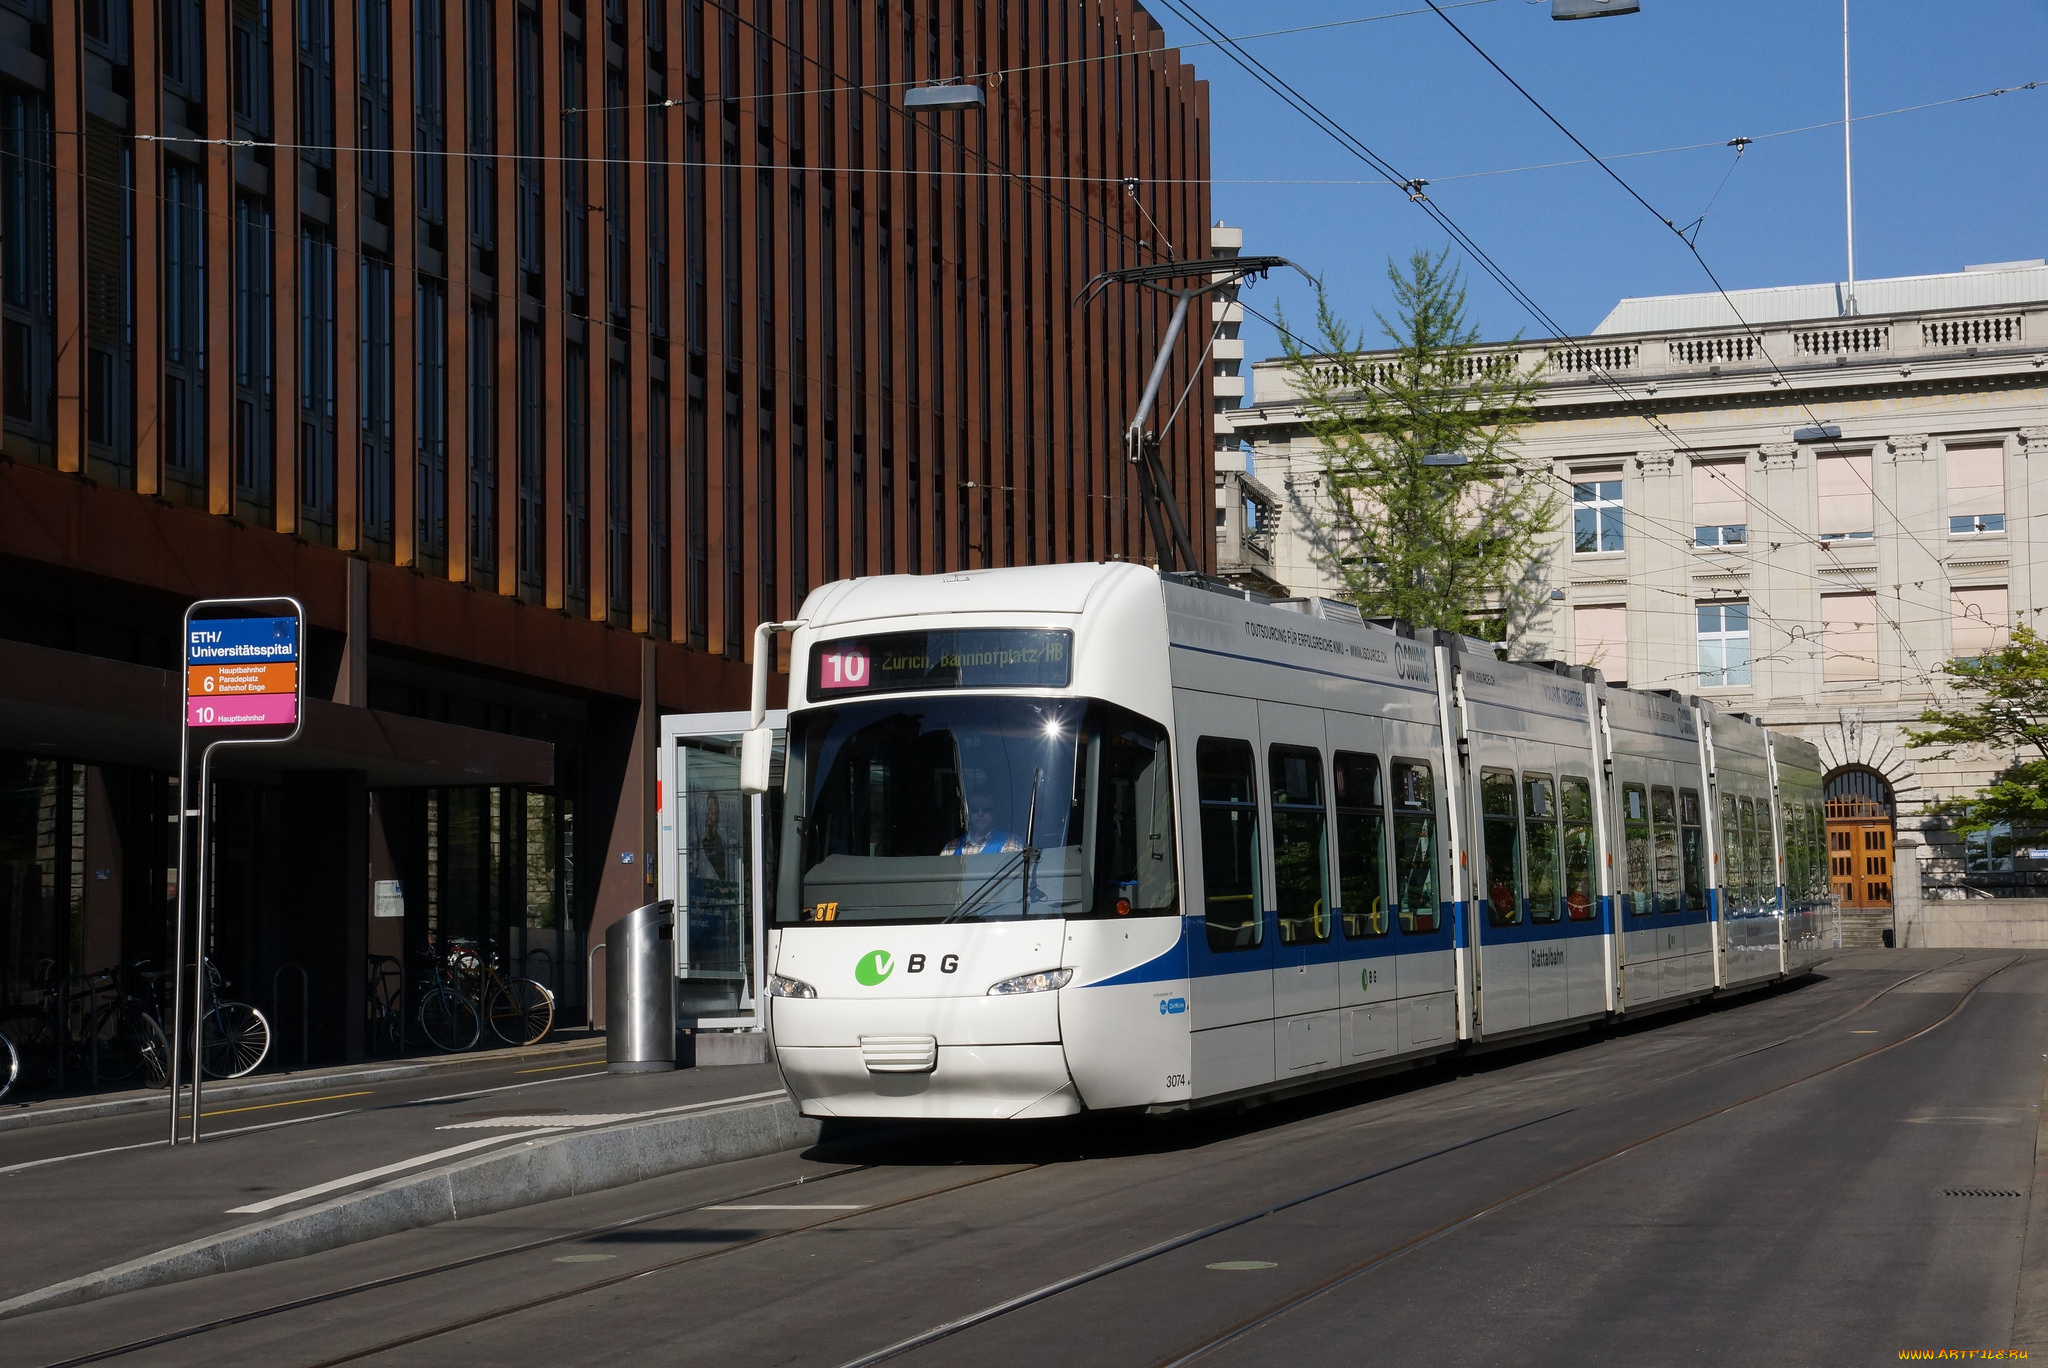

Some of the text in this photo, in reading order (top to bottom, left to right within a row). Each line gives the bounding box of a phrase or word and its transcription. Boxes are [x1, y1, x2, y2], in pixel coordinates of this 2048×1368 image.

[191, 631, 222, 644] ETH/
[1250, 622, 1287, 644] OUTSOURCING
[1287, 627, 1298, 645] FÜR
[1297, 632, 1334, 653] ERFOLGREICHE
[191, 643, 292, 657] Universitätsspital
[219, 666, 266, 675] Hauptbahnhof
[828, 651, 864, 683] 10
[203, 676, 215, 693] 6
[219, 676, 259, 684] Paradeplatz
[219, 684, 266, 692] Bahnhof Enge
[195, 707, 214, 723] 10
[218, 714, 265, 723] Hauptbahnhof
[1166, 1074, 1185, 1089] 3074
